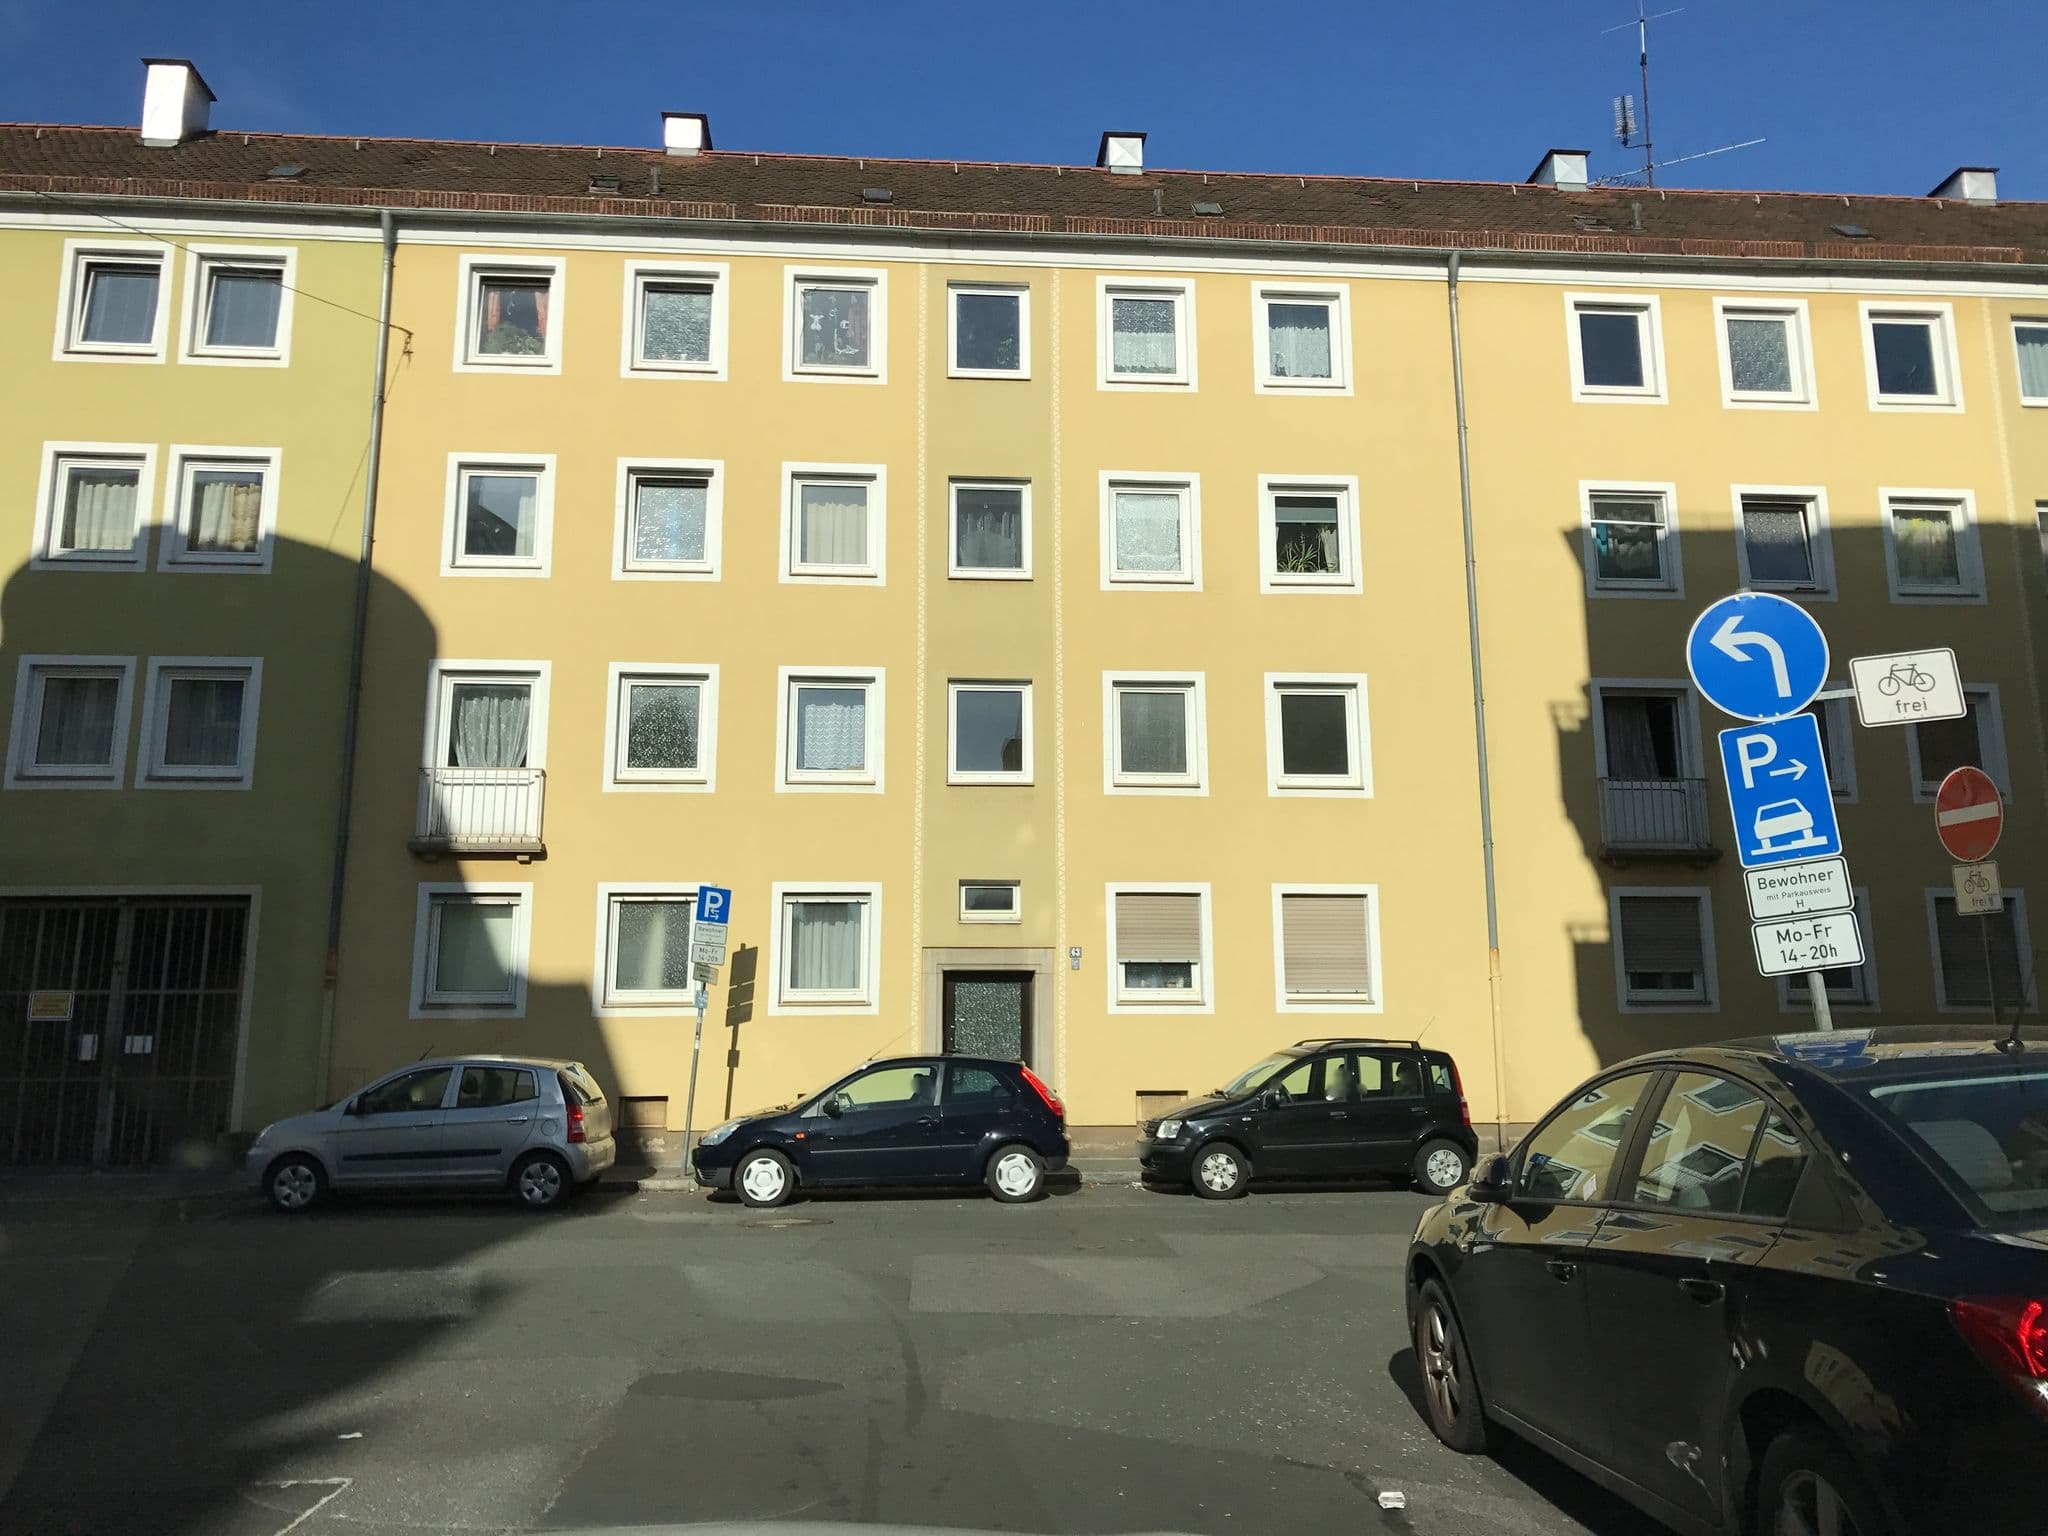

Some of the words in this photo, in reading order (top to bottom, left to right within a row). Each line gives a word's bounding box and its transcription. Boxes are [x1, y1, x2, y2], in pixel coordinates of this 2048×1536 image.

[1896, 697, 1928, 714] frei
[1736, 733, 1778, 790] P
[1757, 870, 1834, 890] Bewohner
[1766, 893, 1779, 901] mit
[1782, 887, 1832, 899] Parkausweis
[1796, 899, 1805, 909] H
[704, 891, 724, 918] P
[1776, 923, 1833, 945] Mo-Fr
[1780, 944, 1838, 964] 14-20h
